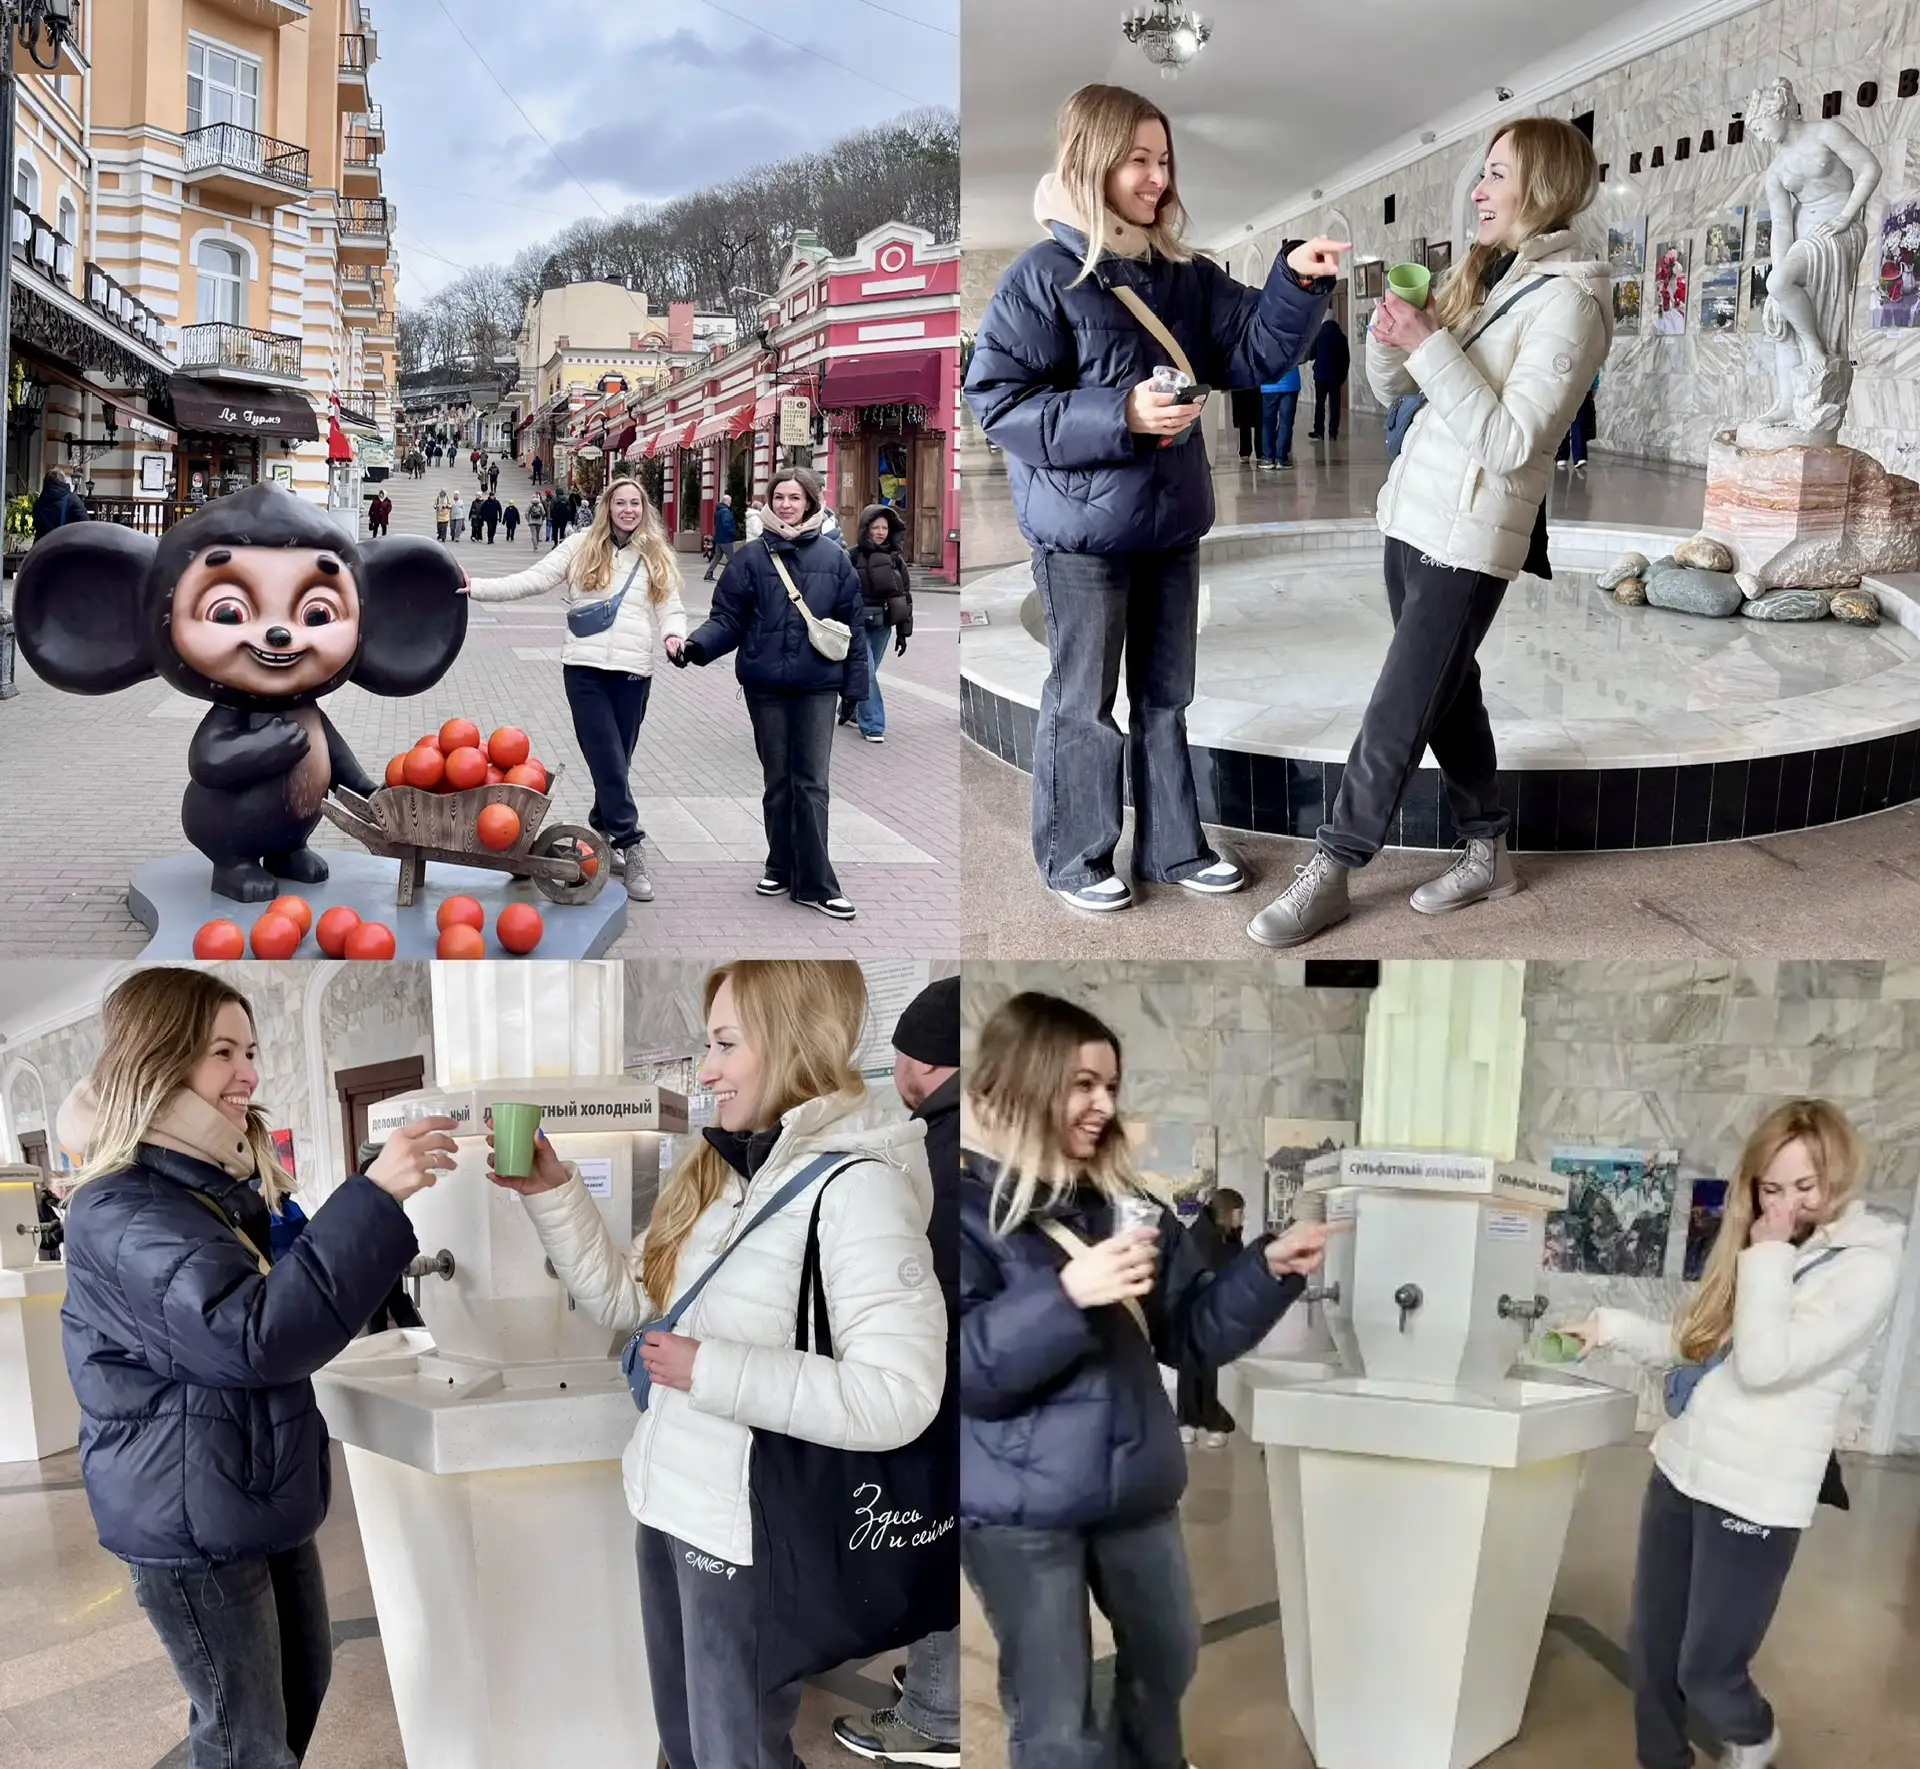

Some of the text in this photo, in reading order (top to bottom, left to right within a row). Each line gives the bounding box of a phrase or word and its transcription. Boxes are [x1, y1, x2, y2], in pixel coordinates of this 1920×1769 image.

[218, 407, 237, 422] Ля
[243, 410, 281, 426] Гурмэ
[580, 1098, 652, 1118] холодный
[372, 1115, 407, 1131] доломит
[849, 1482, 923, 1550] Здесь
[889, 1515, 955, 1548] и сейчас
